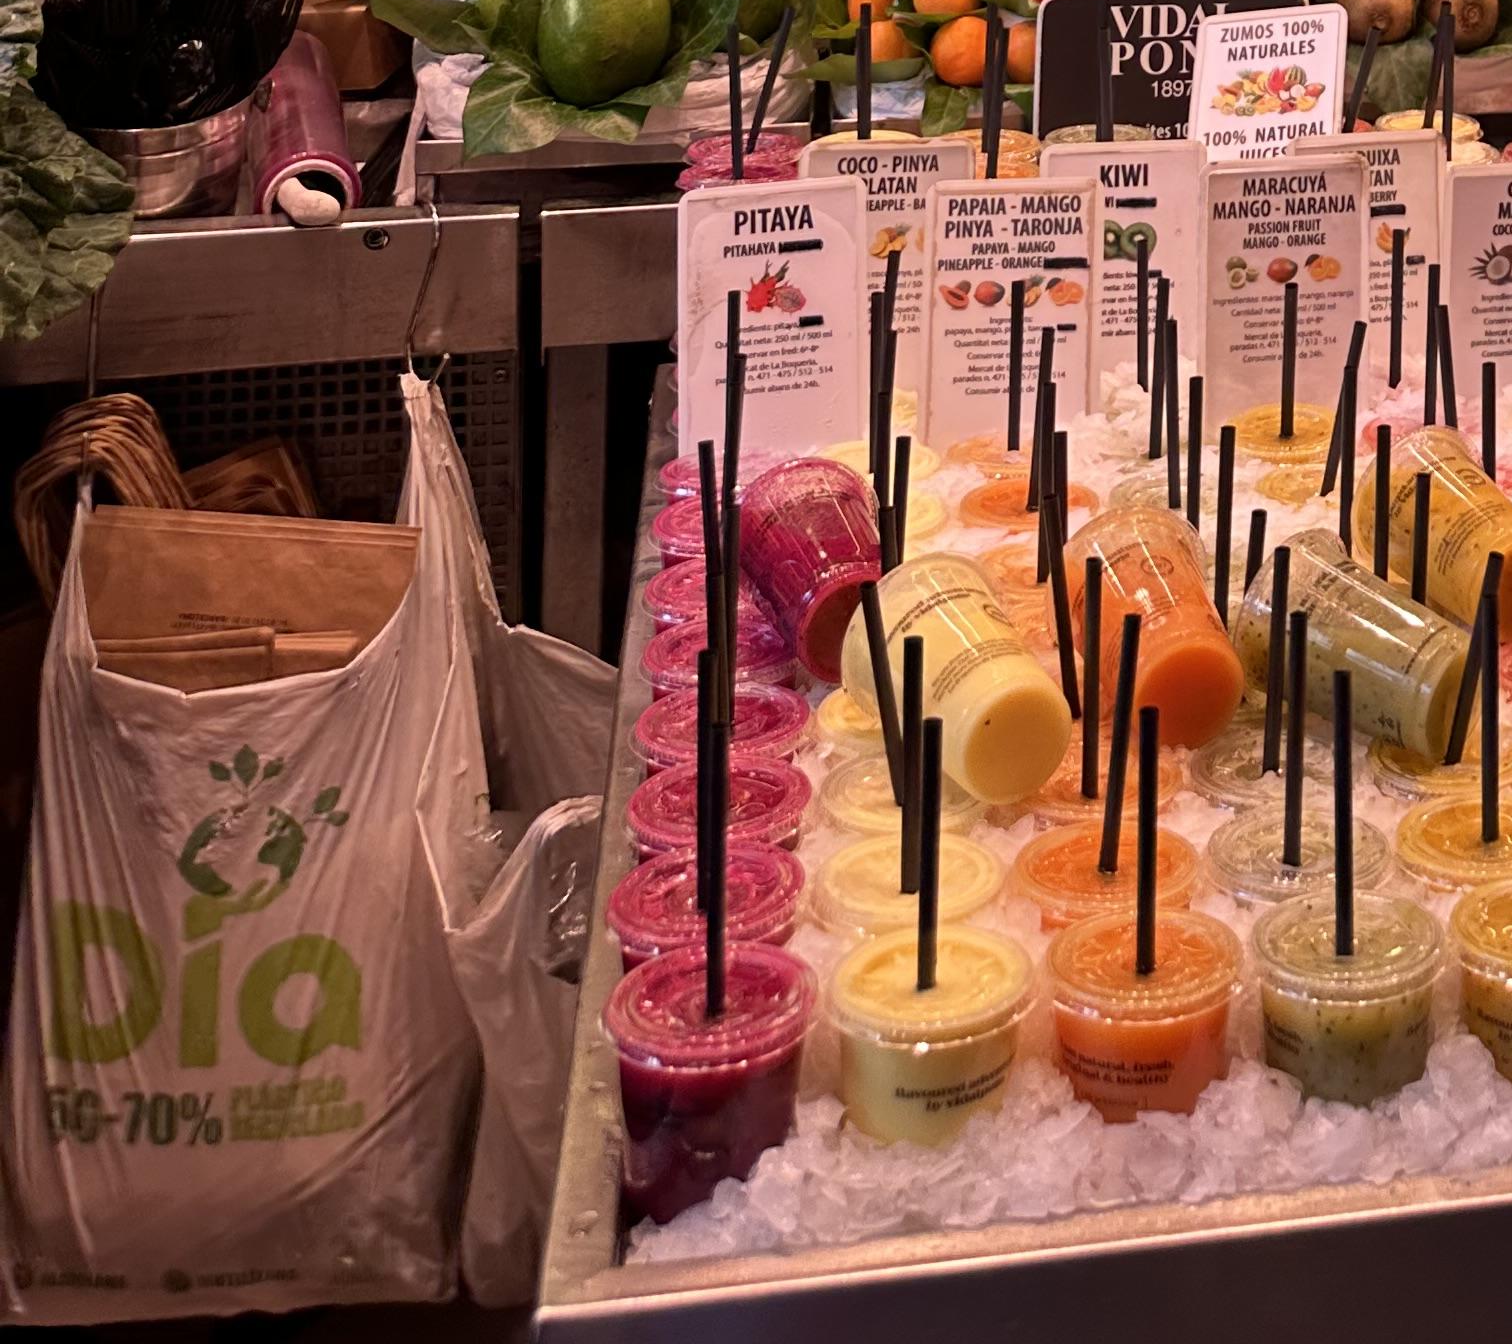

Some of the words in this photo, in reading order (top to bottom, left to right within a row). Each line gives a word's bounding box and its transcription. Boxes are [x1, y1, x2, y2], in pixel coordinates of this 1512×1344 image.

[1110, 3, 1229, 39] VIDA
[1220, 23, 1274, 43] ZUMOS
[1282, 19, 1325, 37] 100%
[1110, 40, 1197, 77] PON
[1227, 39, 1316, 63] NATURALES
[1151, 79, 1193, 98] 1897
[1202, 128, 1246, 147] 100%
[1255, 121, 1327, 144] NATURAL
[837, 156, 879, 175] COCO
[892, 155, 940, 173] PINYA
[1359, 148, 1401, 166] UIXA
[1100, 163, 1149, 188] KIWI
[1242, 171, 1327, 197] MARACUYÁ
[866, 198, 905, 212] EAPPLE
[948, 197, 1006, 217] PAPAIA
[1021, 195, 1082, 215] MANGO
[1213, 198, 1271, 220] MANGO
[1285, 194, 1356, 216] NARANJA
[734, 204, 814, 236] PITAYA
[944, 219, 994, 239] PINYA
[1010, 216, 1083, 237] TARONJA
[1248, 220, 1290, 235] PASSION
[1292, 218, 1322, 232] FRUIT
[723, 241, 776, 259] PITAHAYA
[971, 242, 1010, 255] PAPAYA
[1017, 240, 1056, 253] MANGO
[1243, 236, 1280, 250] MANGO
[1287, 232, 1327, 247] ORANGE
[937, 257, 994, 272] PINEAPPLE
[1002, 256, 1043, 269] ORANGE
